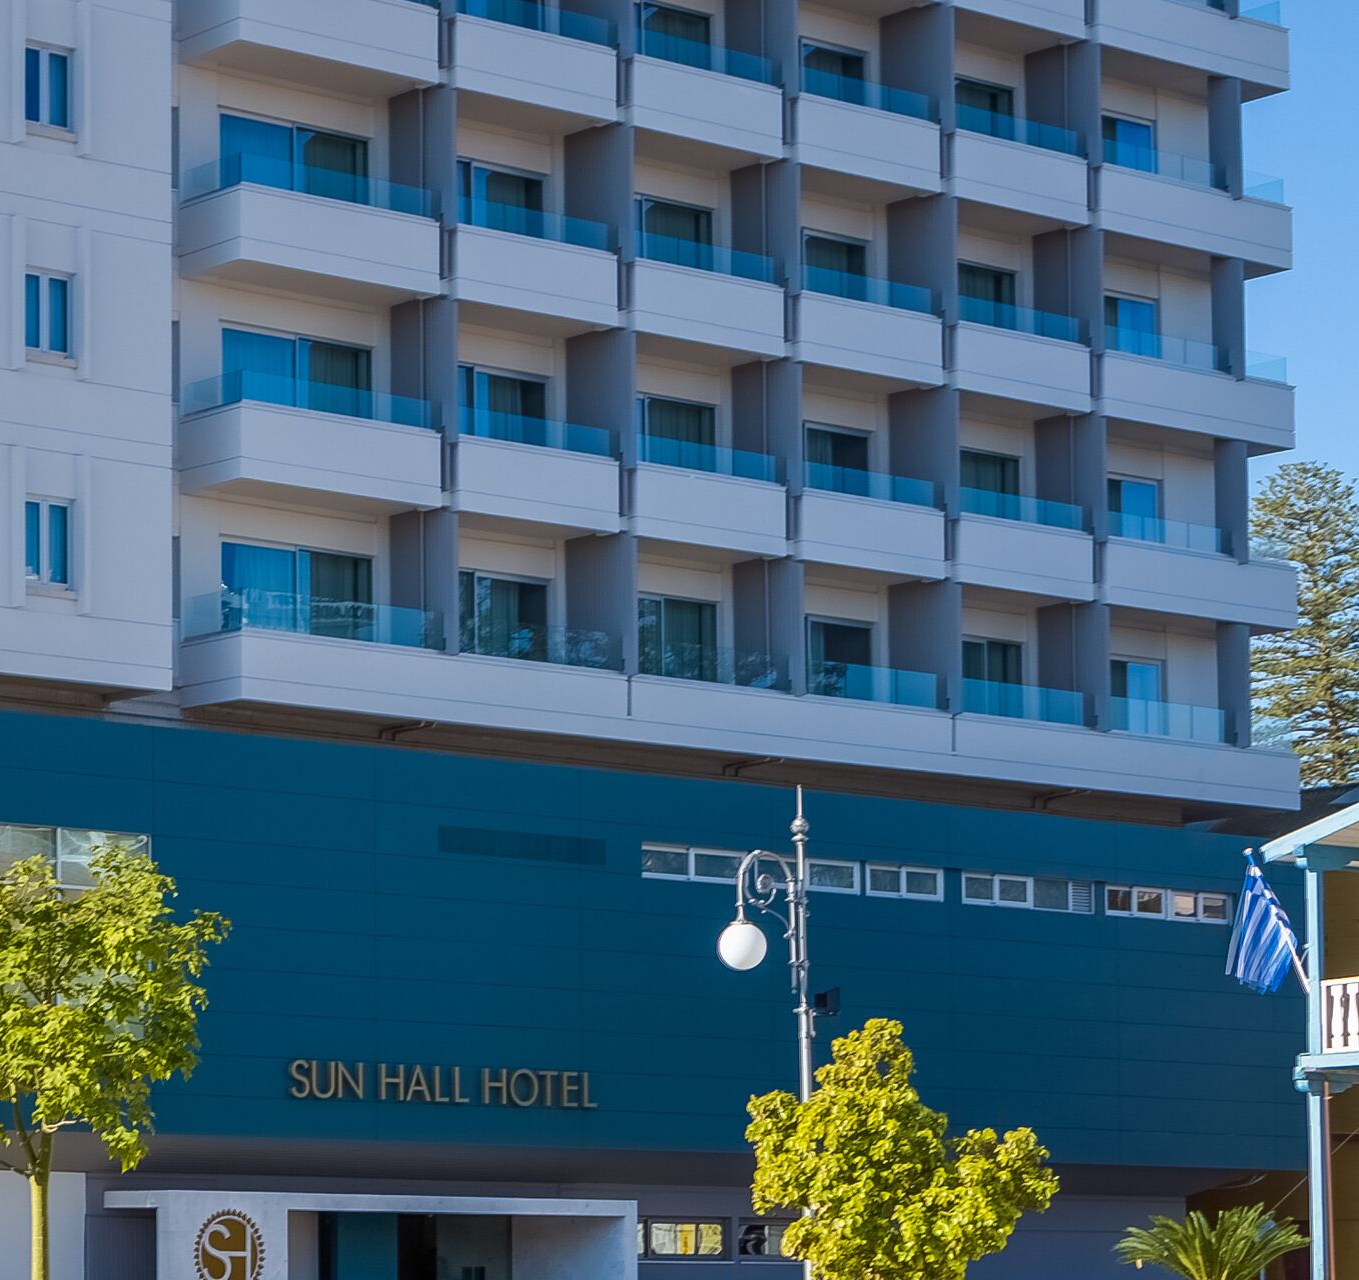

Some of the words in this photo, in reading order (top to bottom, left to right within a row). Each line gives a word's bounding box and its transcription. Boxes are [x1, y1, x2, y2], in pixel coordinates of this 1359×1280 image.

[289, 1059, 364, 1099] SUN
[378, 1063, 470, 1103] HALL
[481, 1067, 598, 1108] HOTEL
